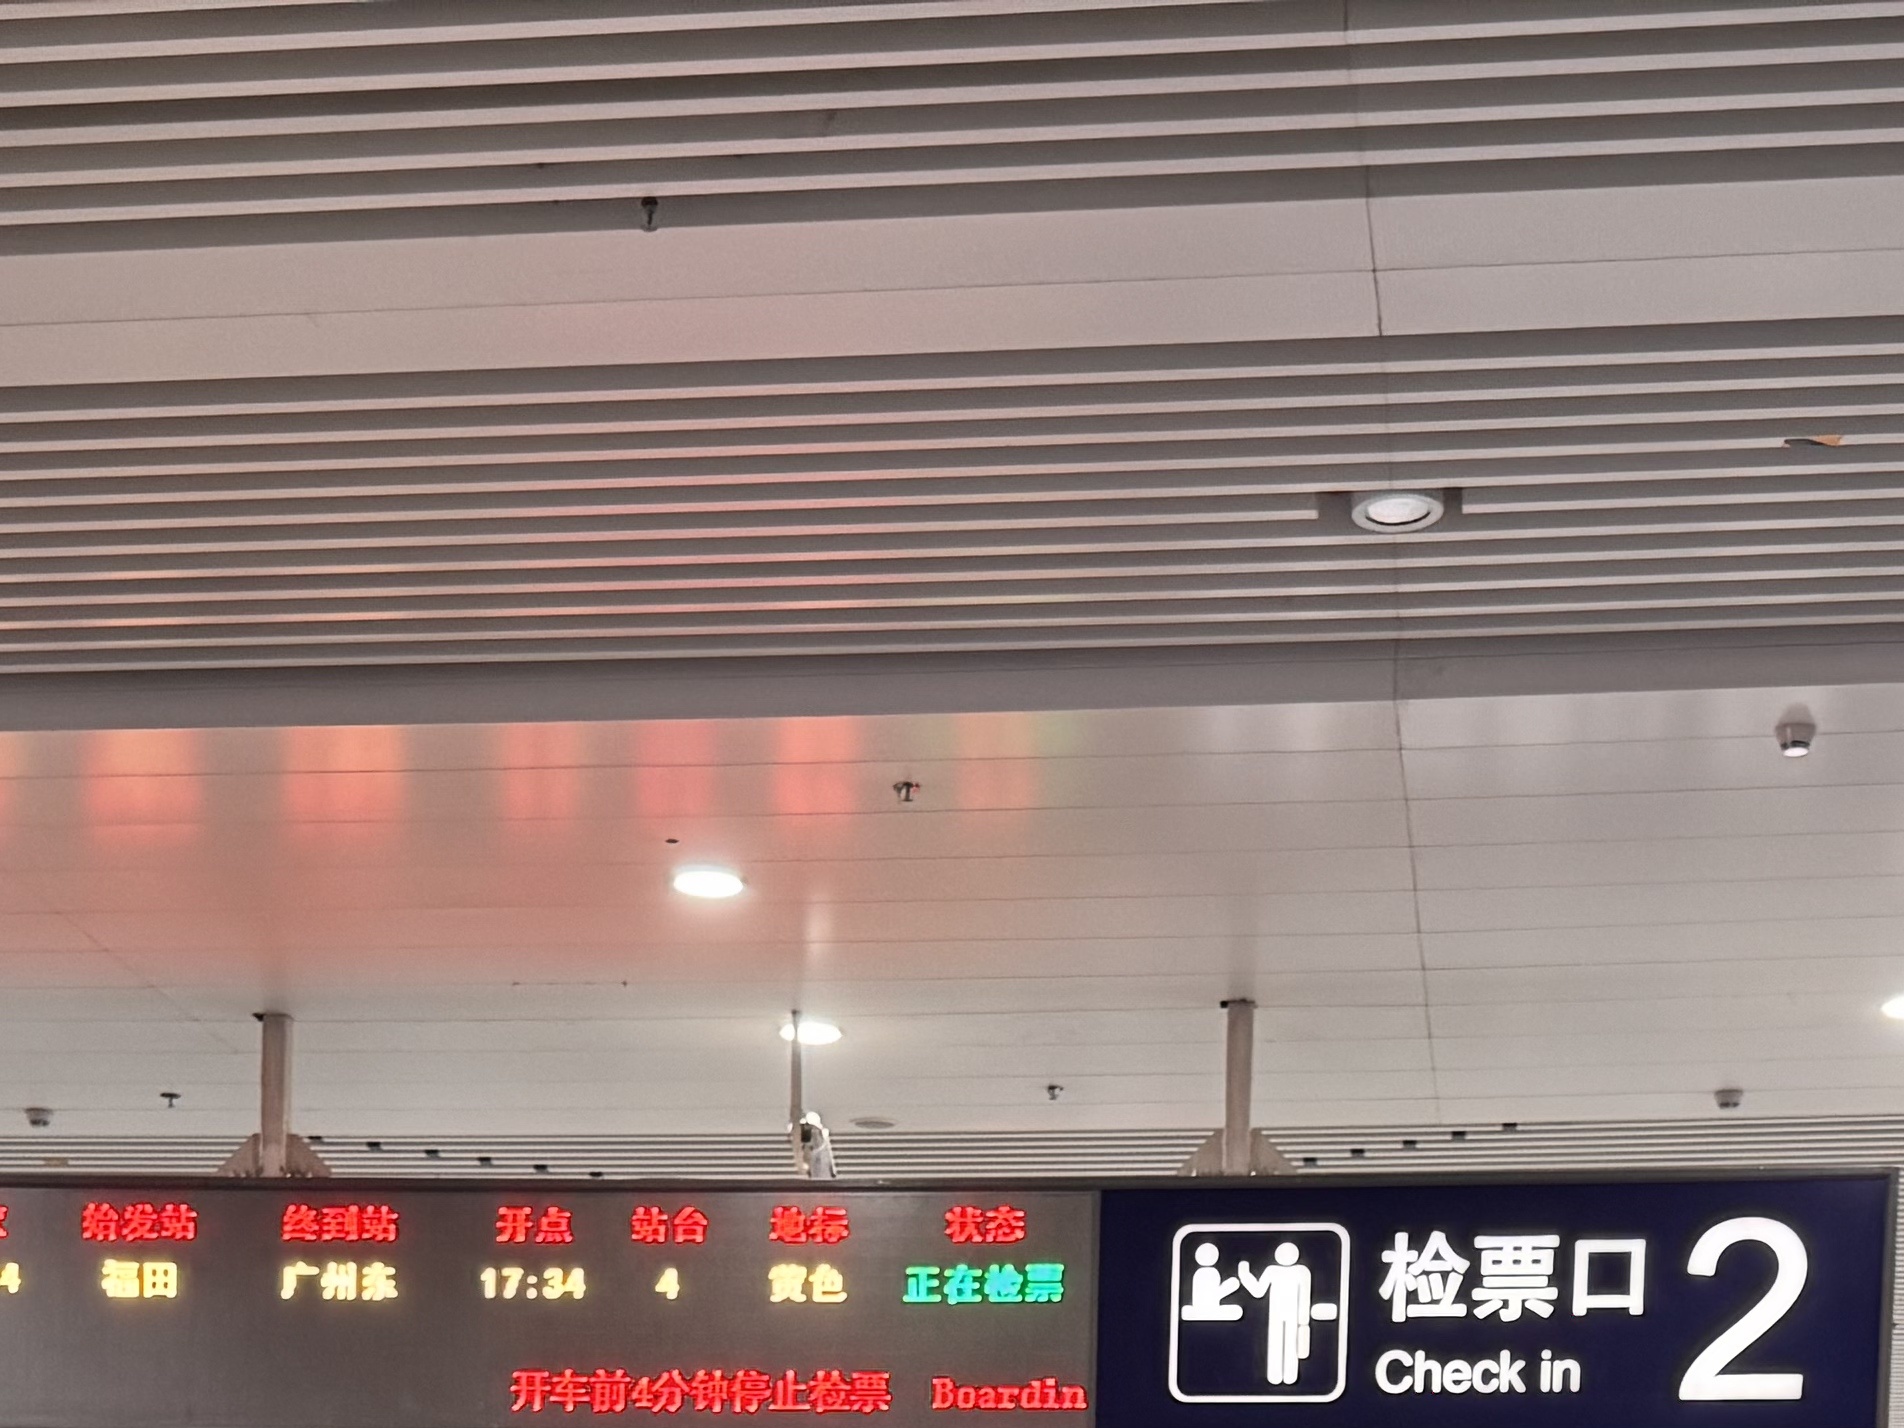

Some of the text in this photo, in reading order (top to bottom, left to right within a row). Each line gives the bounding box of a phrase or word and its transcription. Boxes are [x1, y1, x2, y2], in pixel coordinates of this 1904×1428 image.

[282, 1203, 398, 1242] 终到站
[496, 1206, 575, 1244] 开点
[630, 1206, 709, 1244] 站台
[769, 1206, 849, 1244] 地标
[944, 1206, 1027, 1244] 状态
[101, 1259, 179, 1299] 福田
[281, 1261, 398, 1300] 广州东
[480, 1267, 586, 1300] 17:34
[654, 1267, 680, 1300] 4
[768, 1263, 848, 1303] 黄色
[902, 1263, 1065, 1304] 正在检票
[1378, 1216, 1809, 1401] 检票口 2
[510, 1368, 1088, 1414] 开车前4分钟停止检票 Boardin
[1375, 1349, 1581, 1394] Check in
